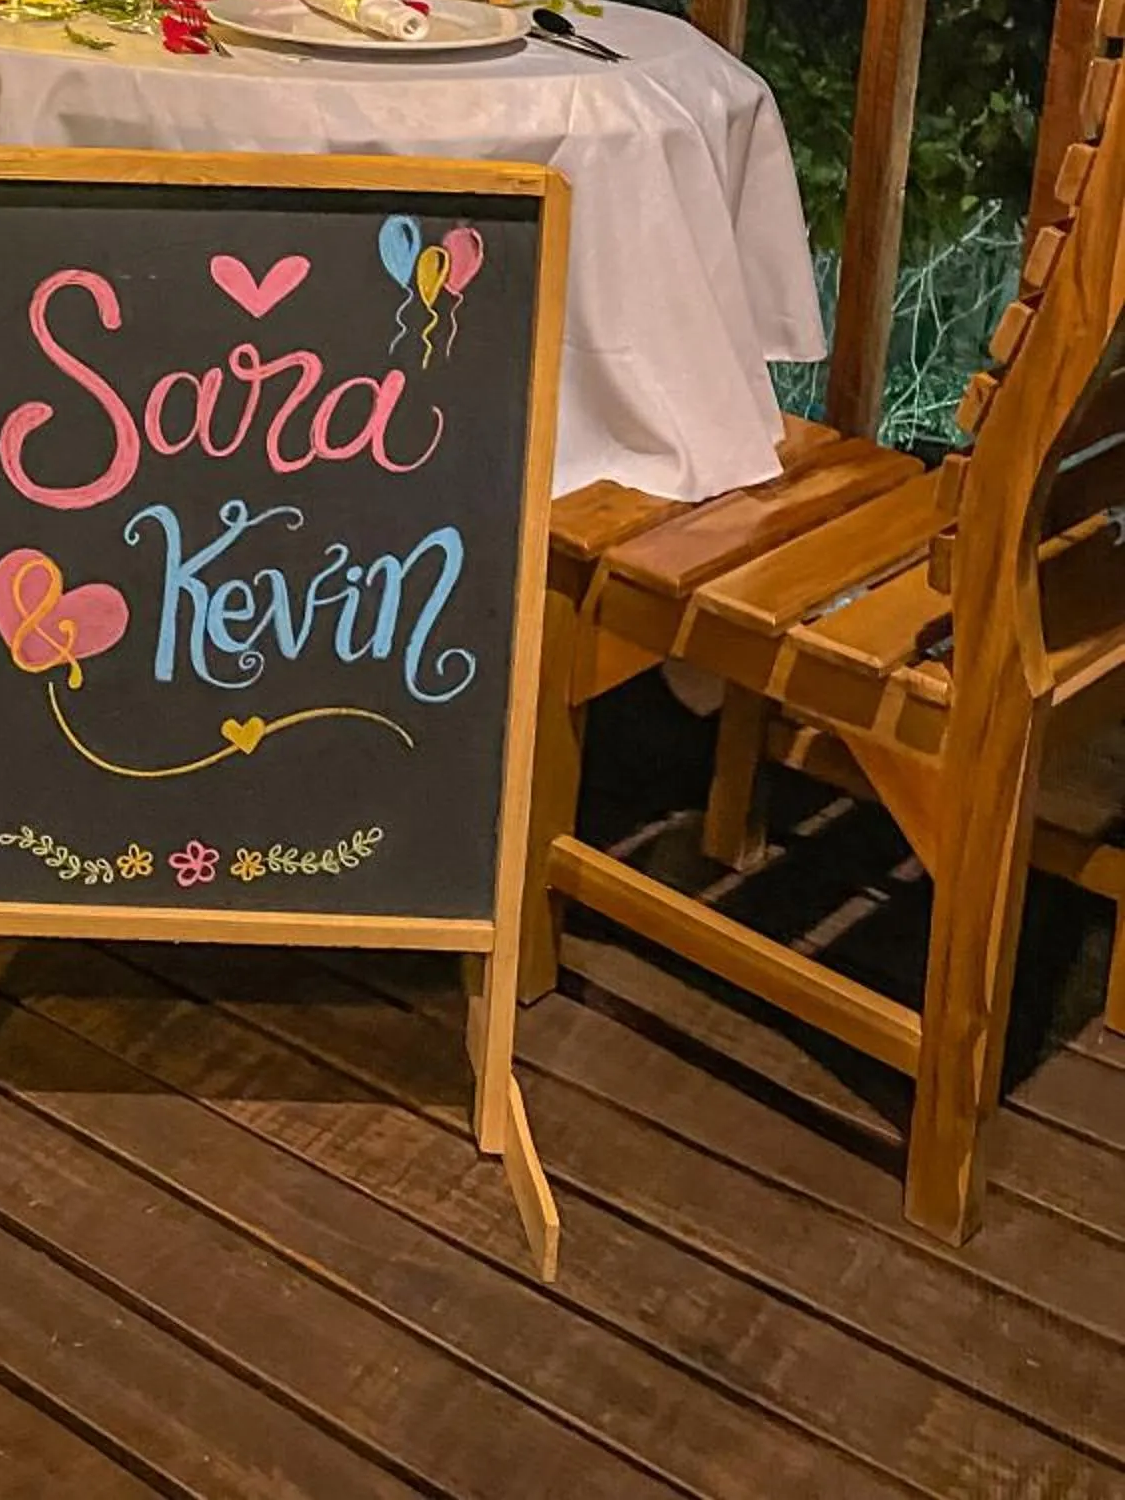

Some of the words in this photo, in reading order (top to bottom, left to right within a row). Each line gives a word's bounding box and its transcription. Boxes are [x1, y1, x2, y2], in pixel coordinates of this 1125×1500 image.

[0, 269, 444, 510] Sara
[10, 556, 81, 690] &
[124, 500, 476, 703] Kevin
